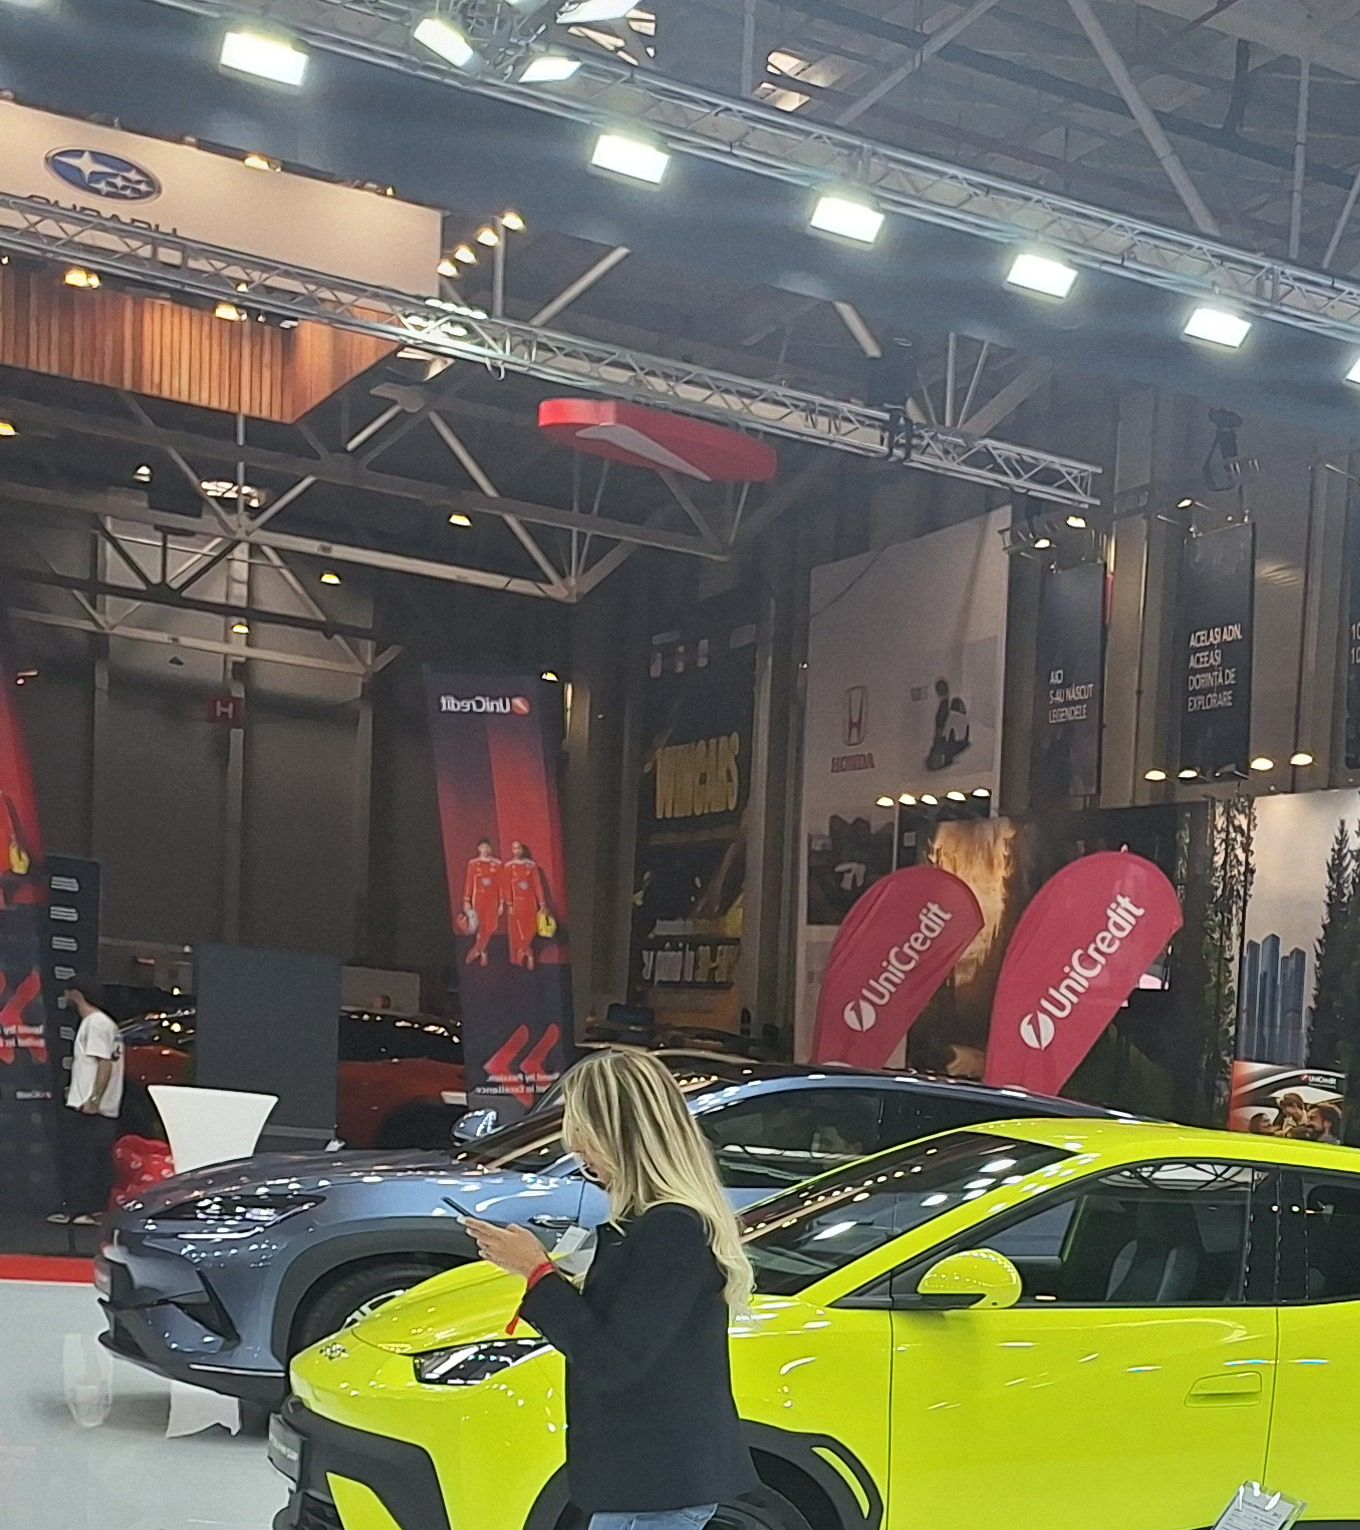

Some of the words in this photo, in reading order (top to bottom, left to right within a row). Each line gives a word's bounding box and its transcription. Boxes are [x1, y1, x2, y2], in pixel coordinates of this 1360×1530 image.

[1224, 668, 1237, 685] DE
[861, 901, 952, 1006] UniCredit
[1041, 893, 1145, 1019] UniCredit
